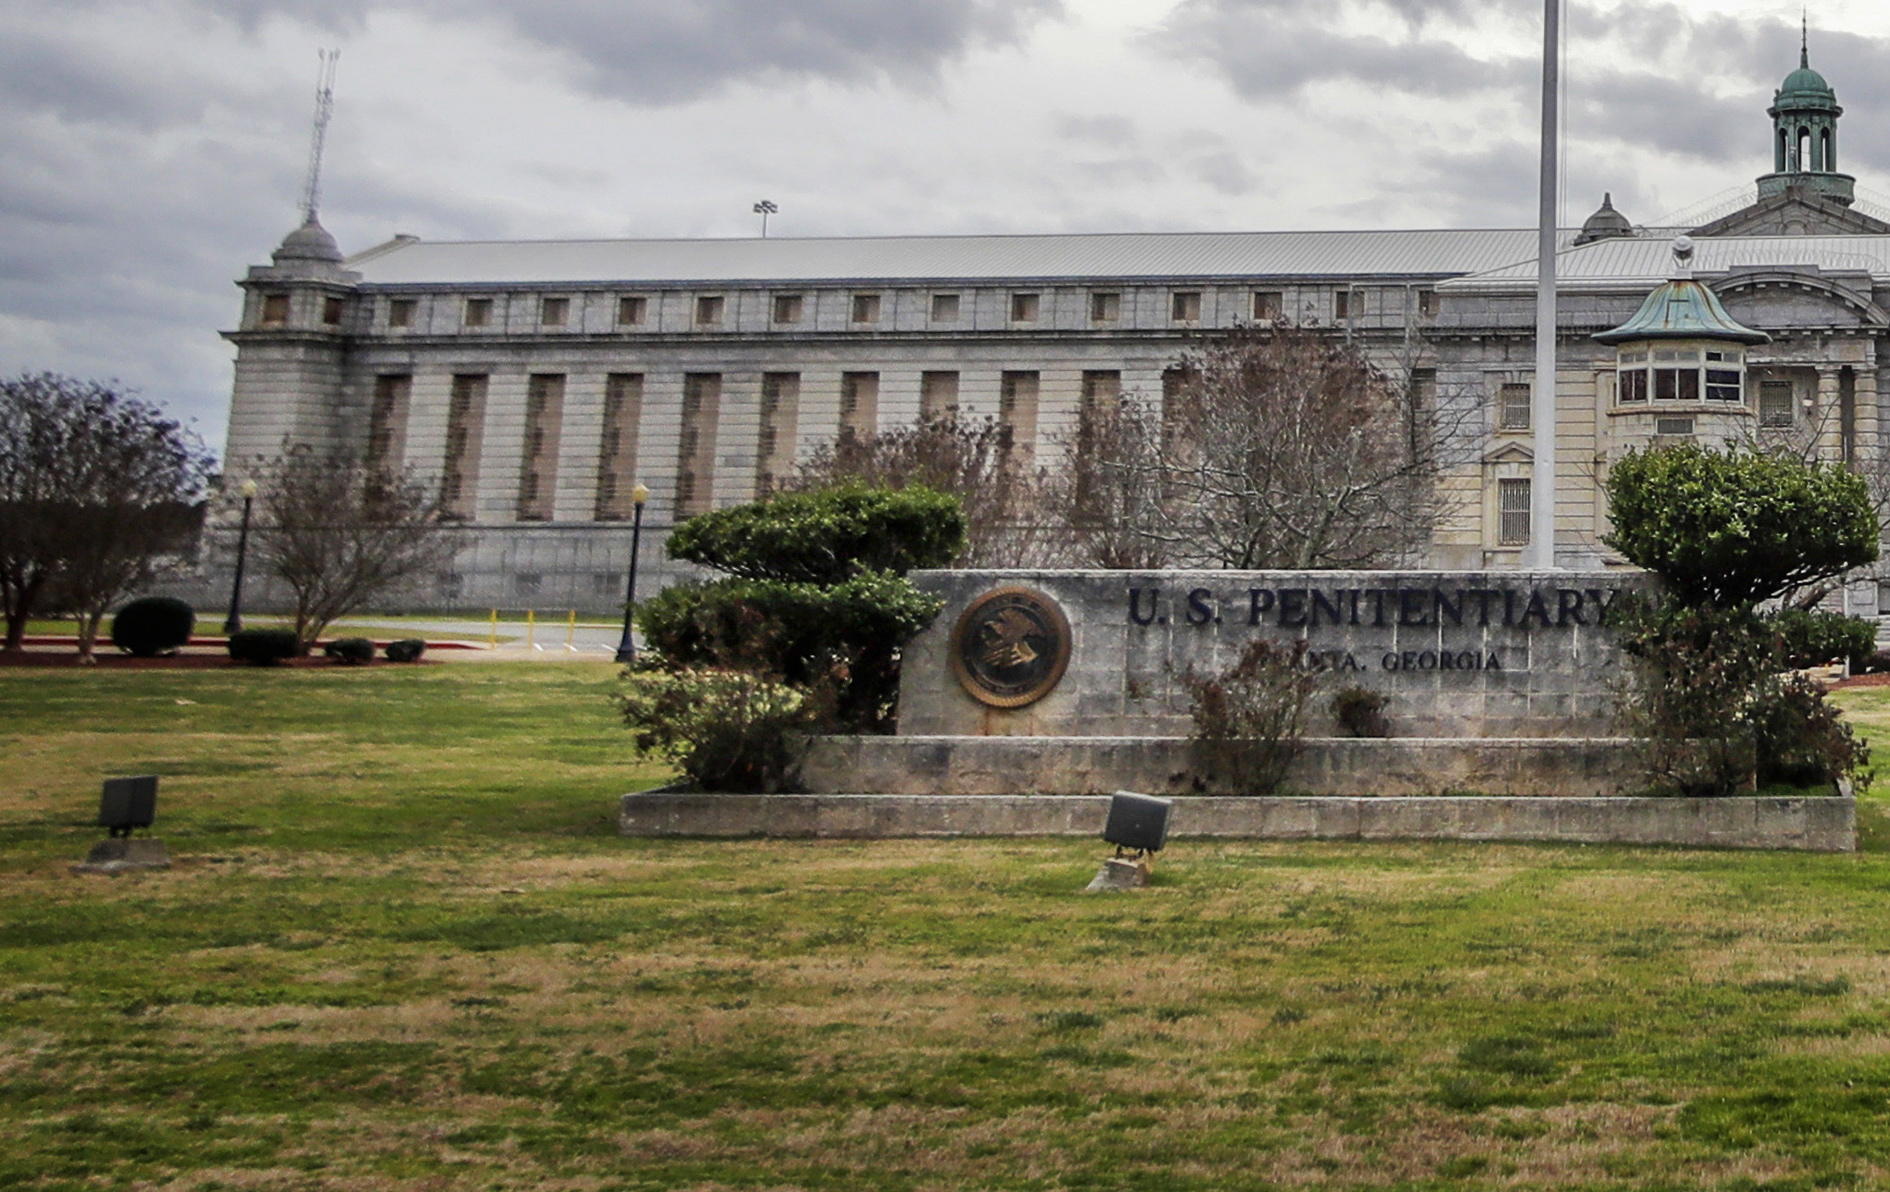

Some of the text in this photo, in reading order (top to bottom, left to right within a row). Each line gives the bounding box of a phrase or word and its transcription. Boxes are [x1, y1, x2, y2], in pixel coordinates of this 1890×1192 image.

[1128, 587, 1621, 627] U. S. PENITENTIARY
[1381, 650, 1501, 672] GEORGIA
